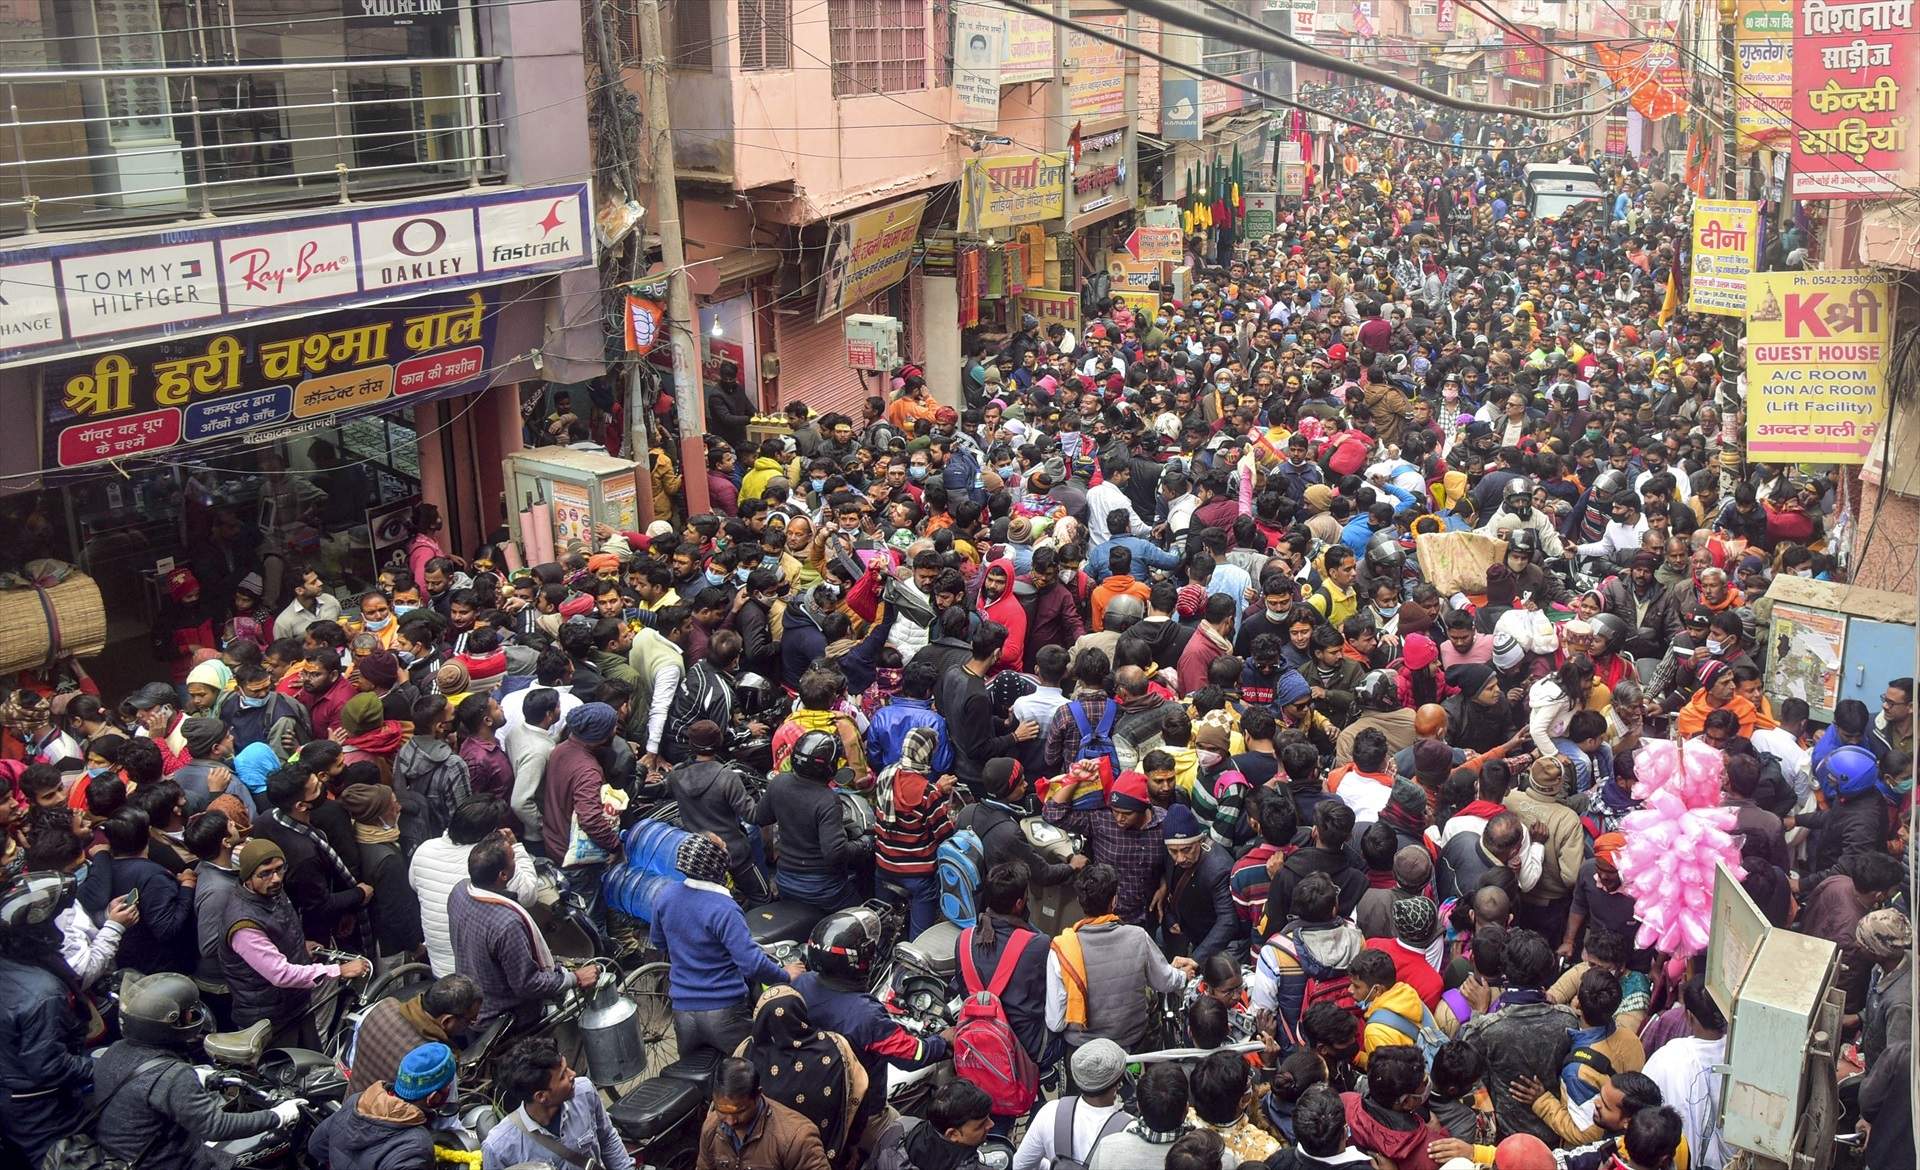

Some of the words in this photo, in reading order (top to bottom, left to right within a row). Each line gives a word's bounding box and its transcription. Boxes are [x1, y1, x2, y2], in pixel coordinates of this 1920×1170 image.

[1802, 0, 1914, 35] विश्वनाथ
[1821, 40, 1892, 73] साड़ीज
[1808, 76, 1899, 113] फैन्सी
[493, 236, 570, 262] fastrack
[1700, 220, 1747, 251] दीना
[76, 263, 172, 292] TOMMY
[382, 257, 461, 285] OAKLEY
[1128, 273, 1148, 285] सरदार
[1794, 277, 1809, 286] Ph.
[93, 284, 199, 316] HILFIGER
[1785, 293, 1832, 338] K
[1823, 289, 1882, 333] श्री
[62, 354, 137, 415] श्री
[153, 336, 243, 404] हरी
[261, 323, 392, 379] चश्मा
[405, 293, 486, 351] वाले
[1755, 346, 1813, 361] GUEST
[1818, 345, 1880, 361] HOUSE
[401, 373, 425, 387] कान
[428, 366, 442, 380] की
[445, 359, 478, 376] मशीन
[1772, 370, 1802, 380] A/C
[1809, 370, 1867, 380] ROOM
[1763, 385, 1794, 395] NON
[1799, 385, 1824, 395] A/C
[1830, 385, 1876, 395] ROOM
[235, 413, 250, 425] की
[1767, 401, 1799, 413] (Lift
[1805, 402, 1873, 414] Facility)
[1757, 425, 1809, 436] अन्दर
[1814, 420, 1855, 436] गली
